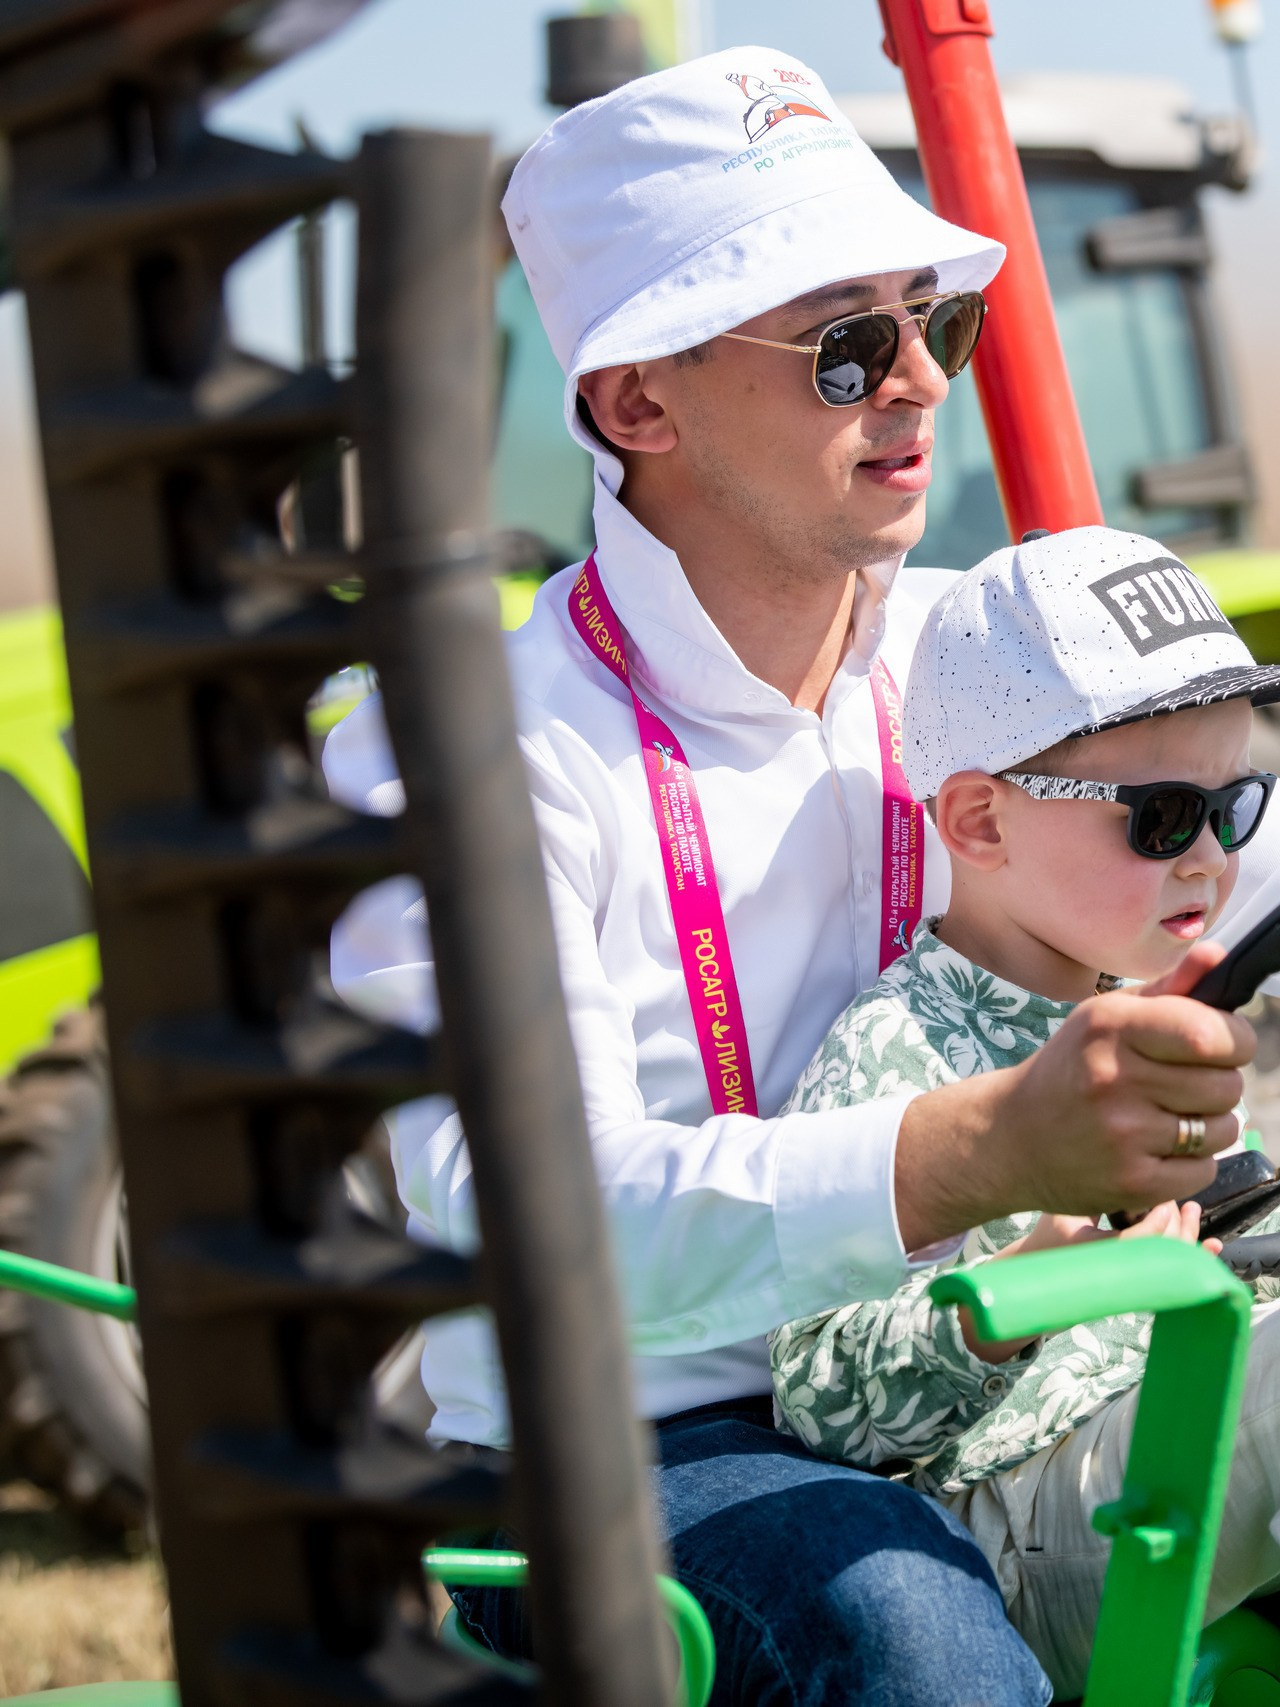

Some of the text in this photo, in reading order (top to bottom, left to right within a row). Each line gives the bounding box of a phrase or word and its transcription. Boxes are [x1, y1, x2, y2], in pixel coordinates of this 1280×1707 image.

[721, 130, 807, 173] РЕСПУБЛИКА
[1106, 567, 1234, 641] FUNN
[659, 783, 685, 891] РЕСПУБЛИКА ТАТАРСТАН
[667, 782, 693, 873] РОССИИ ПО ПАХОТЕ
[677, 781, 698, 832] ОТКРЫТЫЙ
[689, 833, 707, 887] ЧЕМПИОНАТ
[888, 800, 901, 930] 10-й ОТКРЫТЫЙ ЧЕМПИОНАТ
[900, 816, 910, 908] РОССИИ ПО ПАХОТЕ
[909, 852, 917, 908] РЕСПУБЛИКА
